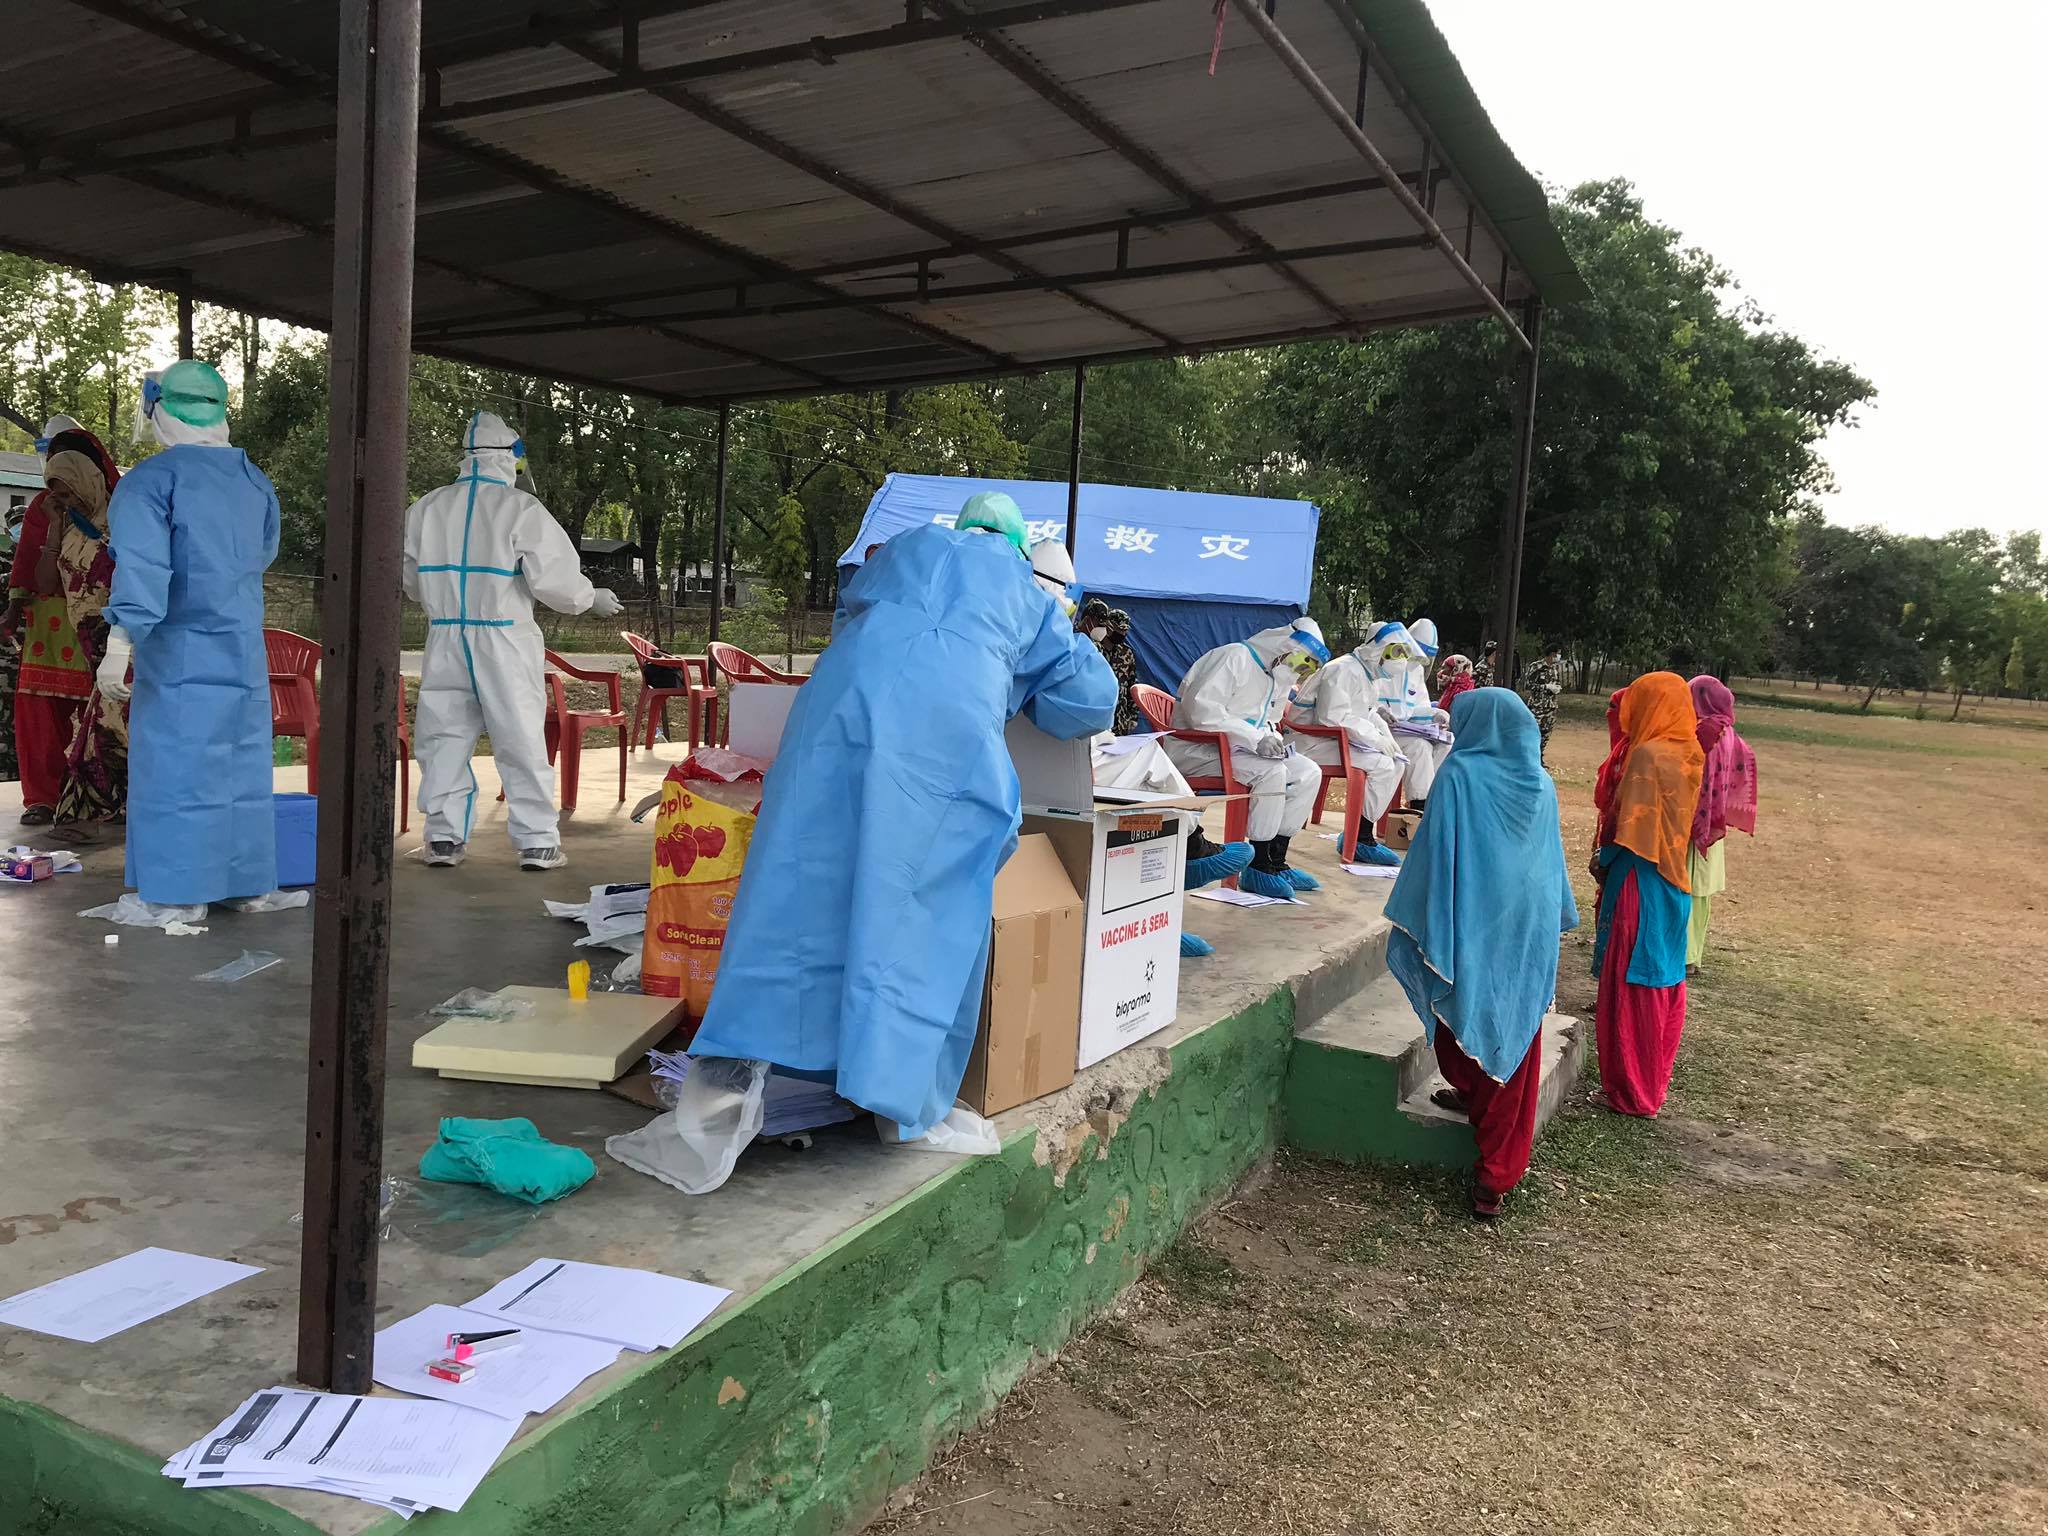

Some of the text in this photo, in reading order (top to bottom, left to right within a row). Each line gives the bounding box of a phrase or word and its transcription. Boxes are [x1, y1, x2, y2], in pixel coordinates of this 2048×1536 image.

[689, 933, 721, 945] Clean
[1101, 911, 1169, 950] VACCINE & SERA
